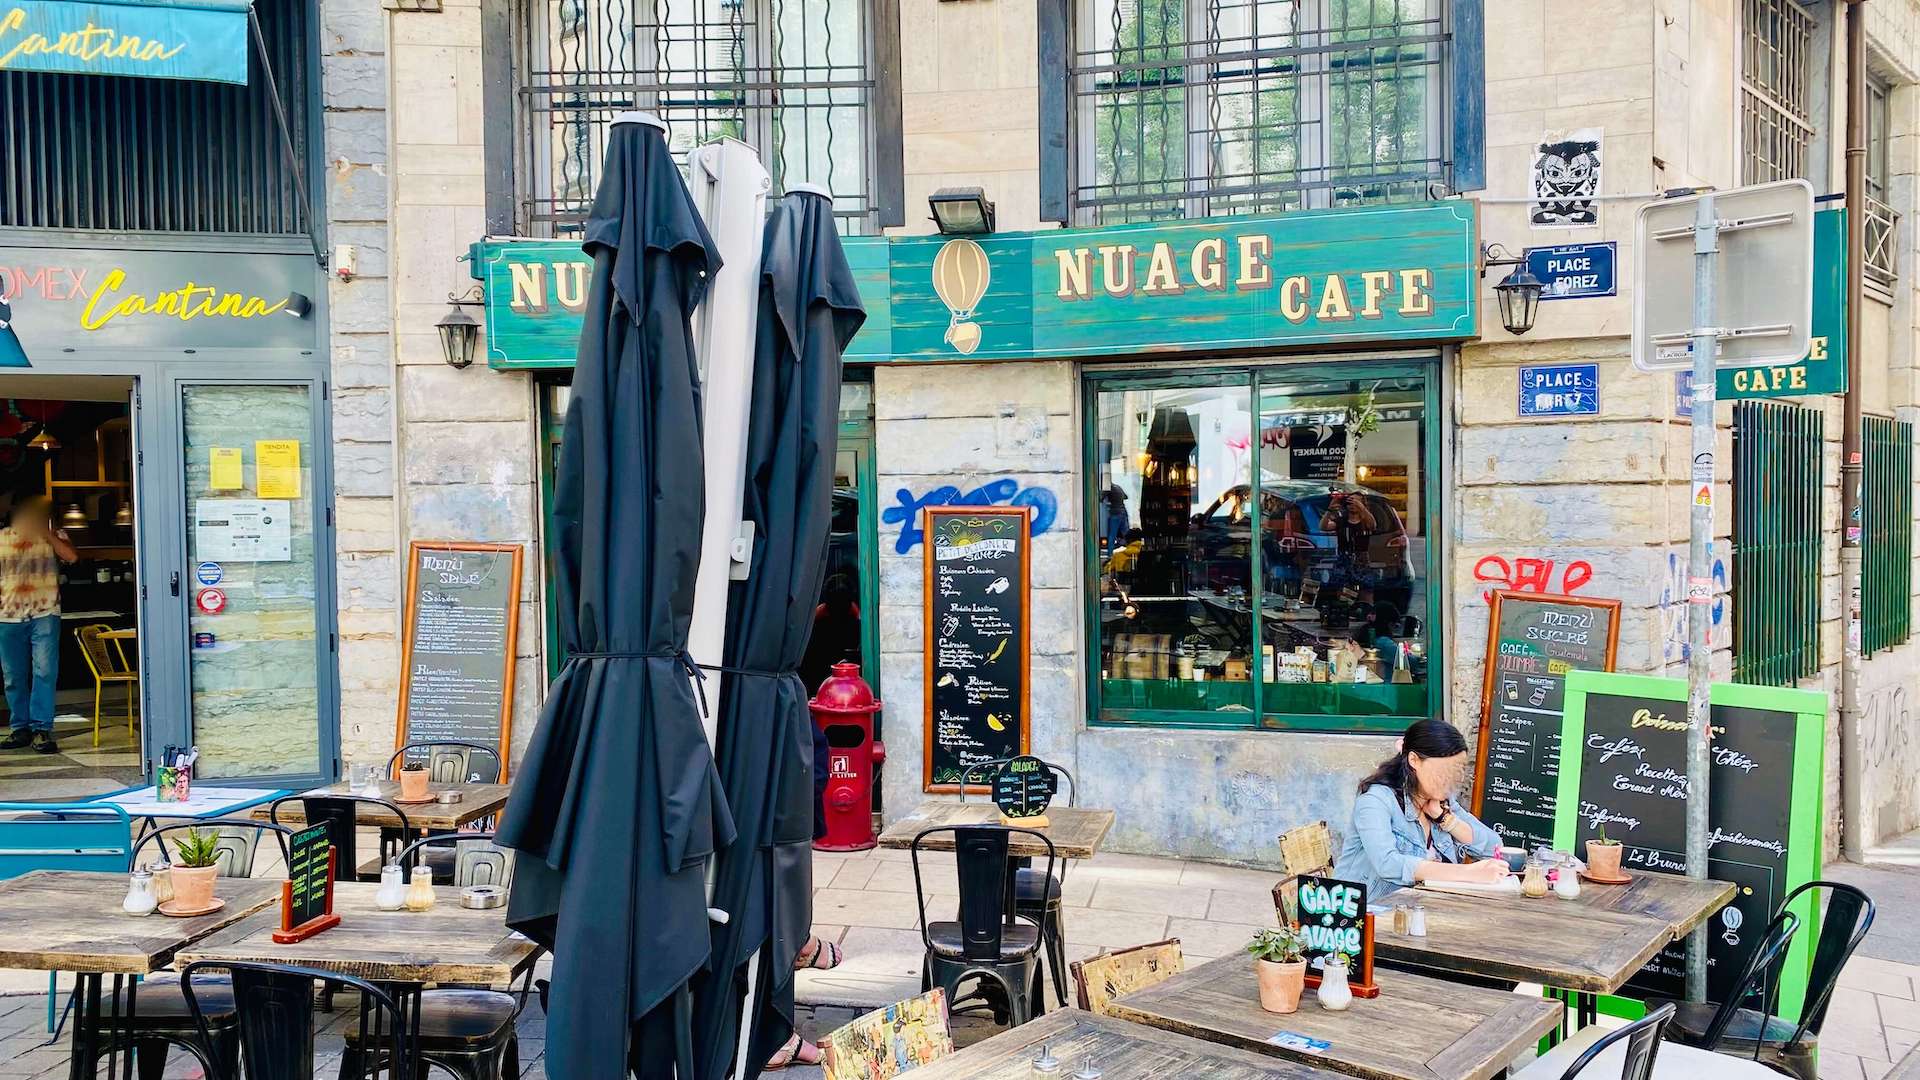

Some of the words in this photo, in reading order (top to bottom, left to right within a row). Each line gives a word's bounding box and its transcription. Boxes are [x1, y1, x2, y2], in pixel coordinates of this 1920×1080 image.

[0, 8, 186, 66] Cantina
[508, 261, 588, 309] NU
[1055, 234, 1274, 302] NUAGE
[1547, 257, 1591, 273] PLACE
[80, 267, 289, 331] Cantina
[1280, 268, 1434, 322] CAFE
[1535, 372, 1583, 388] PLACE
[1733, 366, 1808, 393] CAFE
[1299, 883, 1362, 919] CAFE
